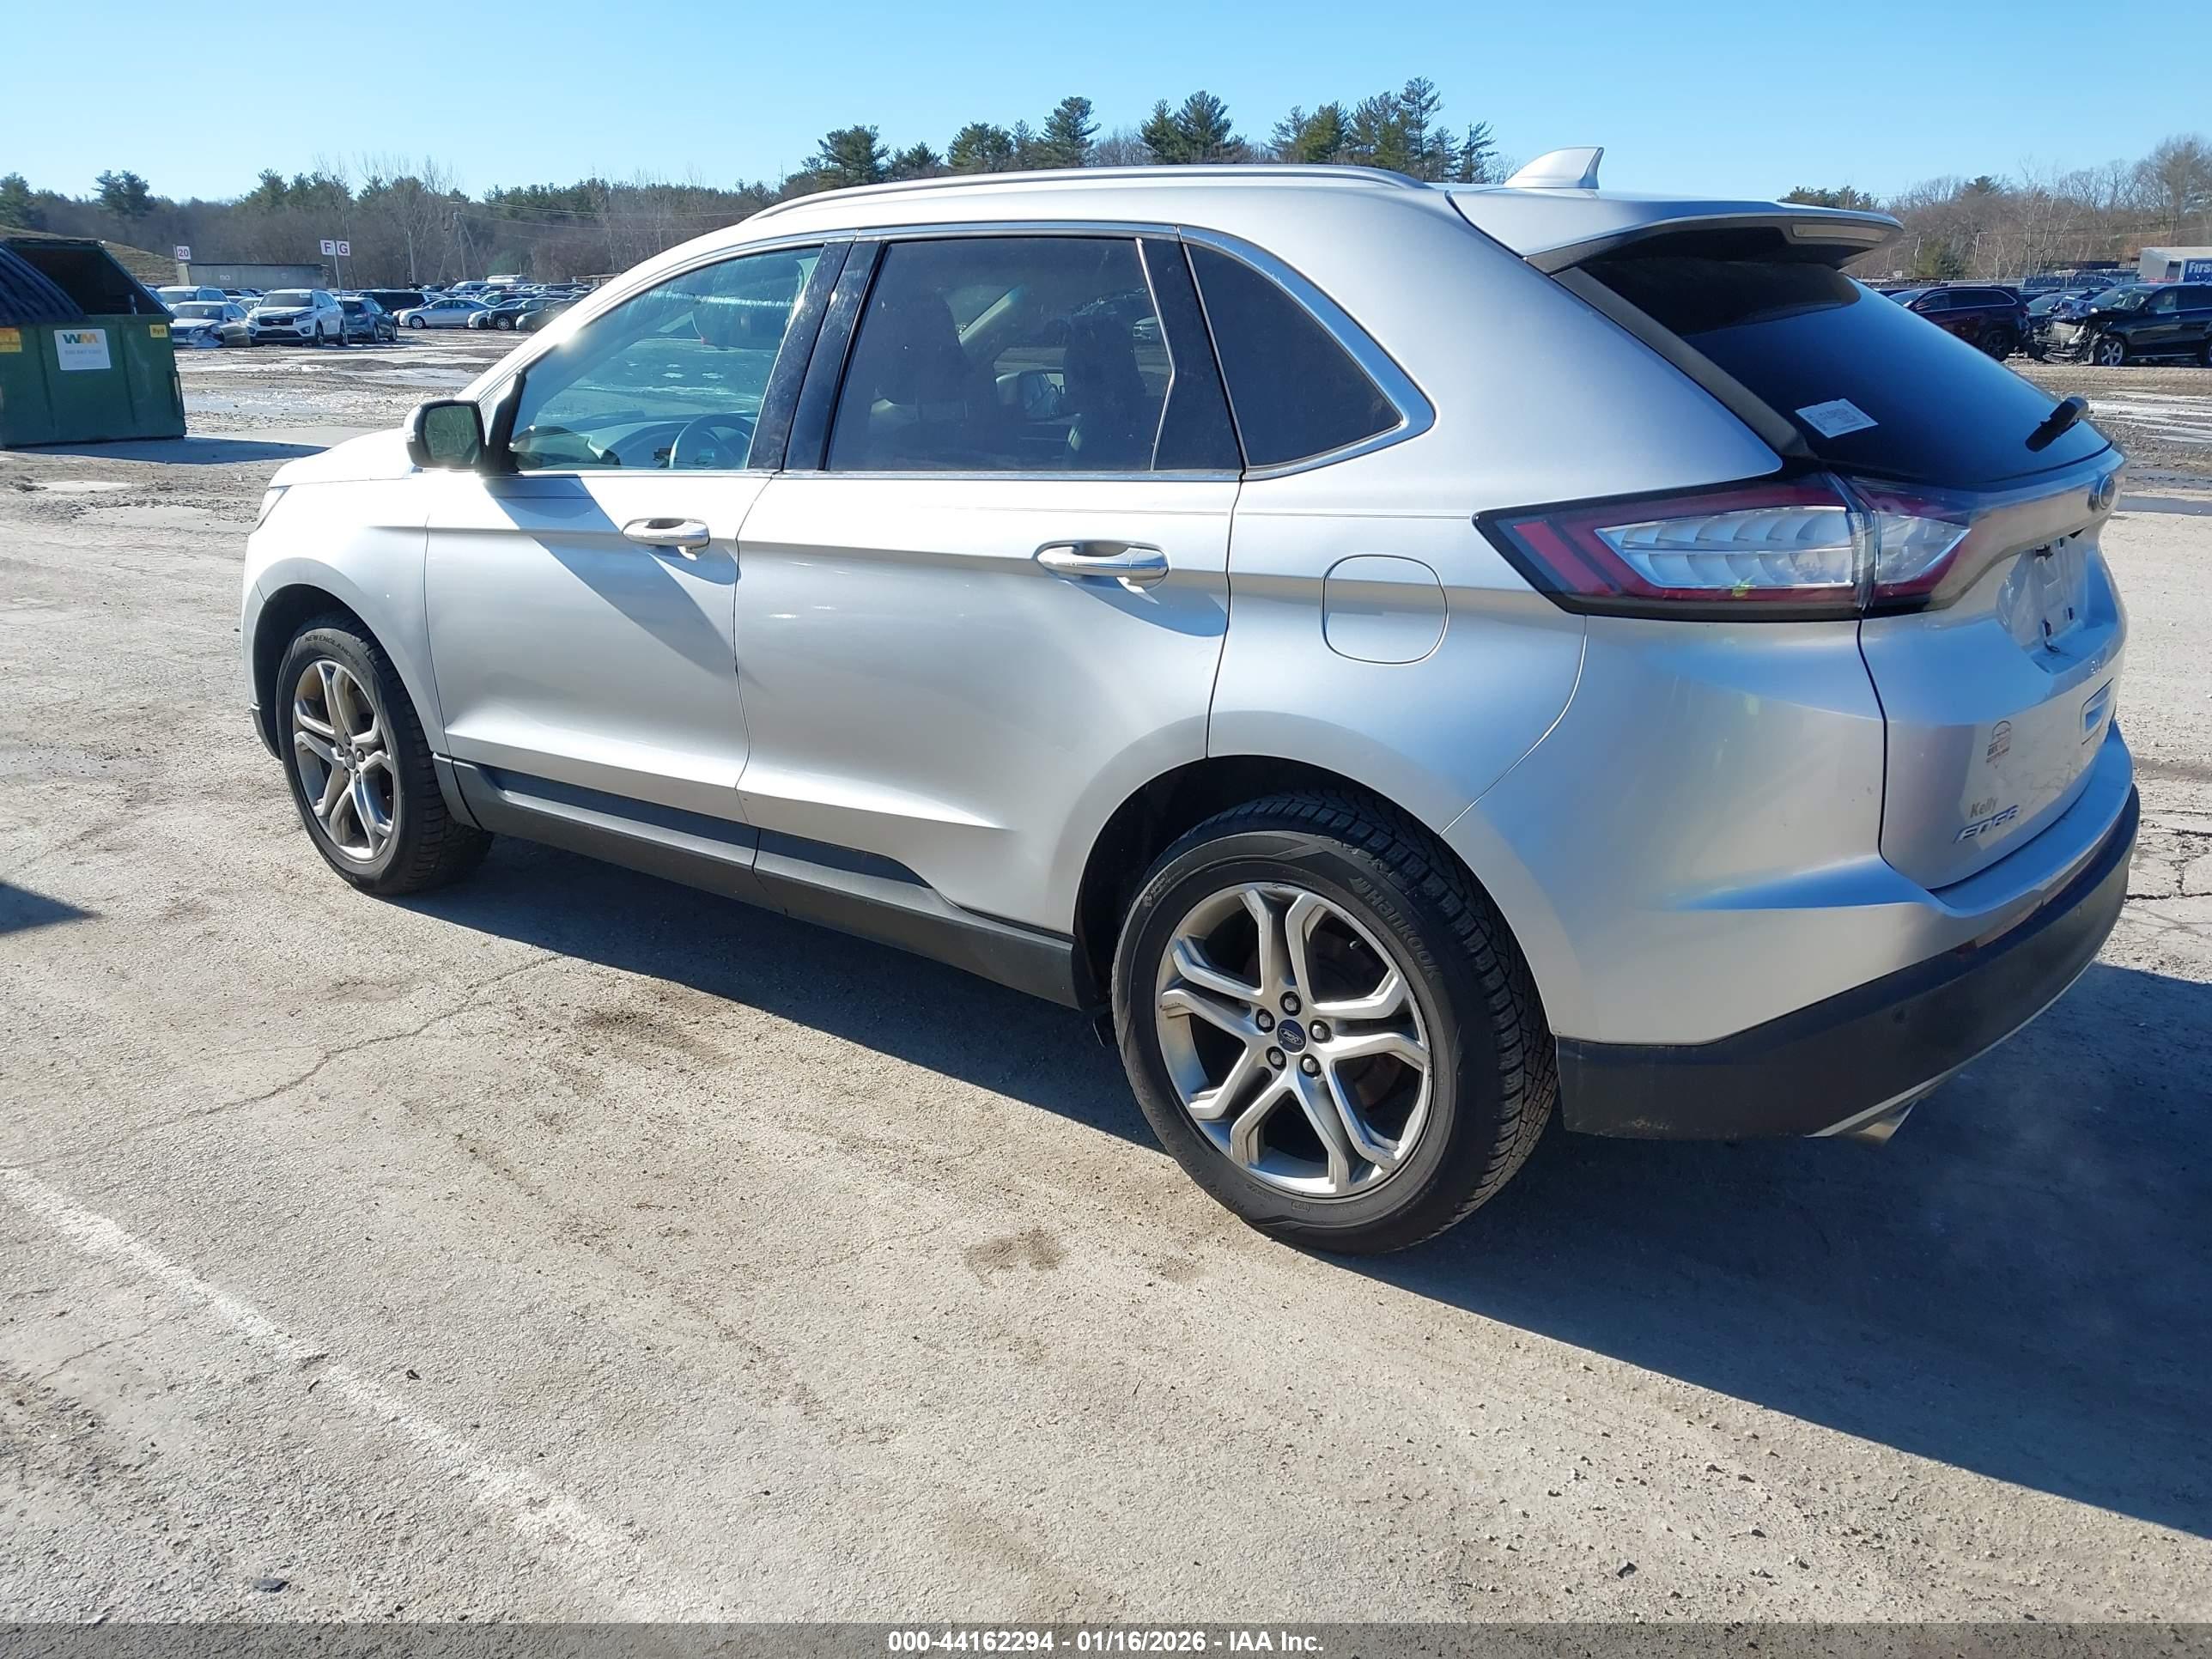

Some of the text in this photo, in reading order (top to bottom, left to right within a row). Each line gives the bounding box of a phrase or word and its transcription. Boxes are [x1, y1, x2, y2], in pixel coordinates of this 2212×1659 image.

[325, 243, 331, 253] F
[339, 243, 348, 254] G
[62, 333, 98, 344] WM
[1970, 796, 2000, 818] Kelly
